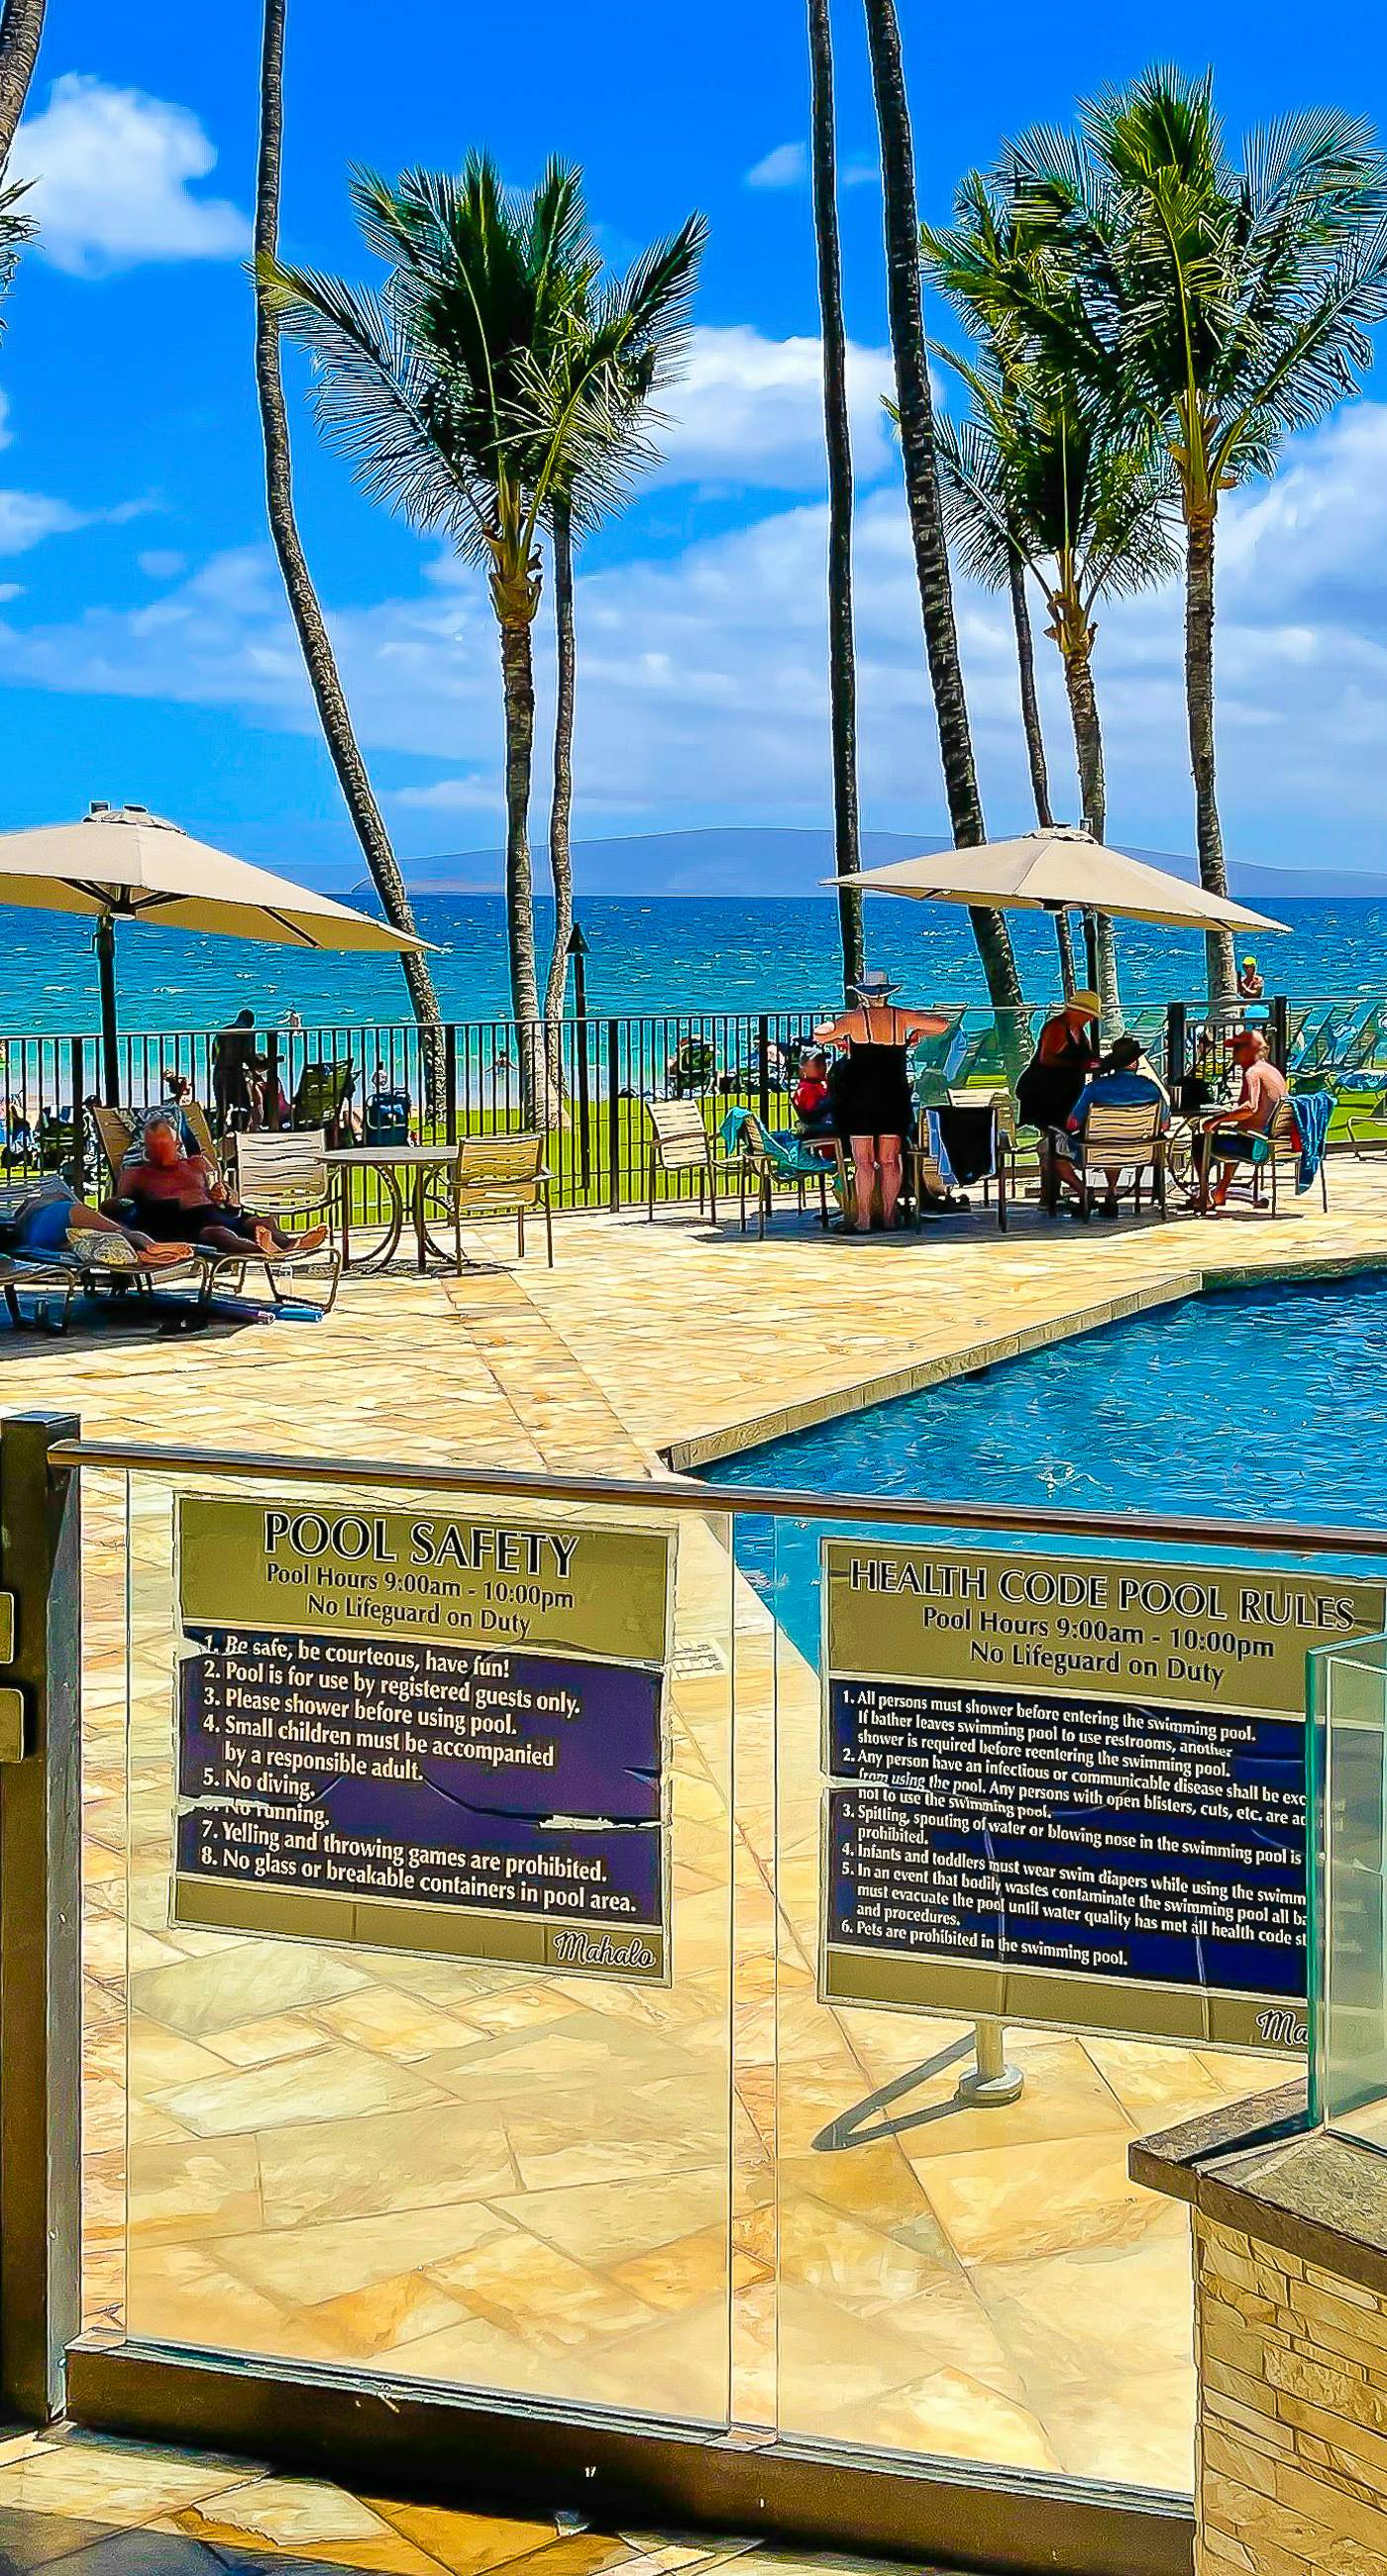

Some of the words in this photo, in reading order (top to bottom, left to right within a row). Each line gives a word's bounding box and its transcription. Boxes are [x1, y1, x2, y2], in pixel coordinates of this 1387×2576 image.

[264, 1511, 397, 1562] POOL
[410, 1521, 580, 1578] SAFETY
[267, 1562, 309, 1584] Pool
[316, 1566, 378, 1590] Hours
[384, 1571, 461, 1597] 9:00am
[483, 1581, 574, 1613] 10:00pm
[849, 1558, 988, 1600] HEALTH
[998, 1568, 1109, 1609] CODE
[1119, 1577, 1227, 1620] POOL
[1239, 1588, 1355, 1632] RULES
[308, 1594, 339, 1616] No
[346, 1596, 440, 1627] Lifeguard
[447, 1610, 473, 1628] on
[480, 1609, 530, 1640] Duty
[923, 1606, 972, 1630] Pool
[980, 1611, 1048, 1636] Hours
[1056, 1617, 1143, 1645] 9:00am
[1170, 1628, 1275, 1661] 10:00pm
[204, 1635, 219, 1655] 1.
[222, 1635, 248, 1656] Be
[253, 1637, 292, 1661] safe,
[298, 1639, 319, 1660] be
[325, 1647, 419, 1672] courteous,
[425, 1649, 468, 1673] have
[473, 1655, 508, 1677] fun!
[970, 1640, 1005, 1664] No
[1012, 1643, 1120, 1676] Lifeguard
[1128, 1659, 1158, 1677] on
[1167, 1658, 1225, 1693] Duty
[203, 1660, 220, 1677] 2.
[226, 1661, 263, 1682] Pool
[268, 1663, 282, 1684] is
[287, 1664, 313, 1685] for
[319, 1673, 348, 1689] use
[354, 1670, 374, 1698] by
[380, 1674, 470, 1701] registered
[475, 1688, 531, 1709] guests
[536, 1690, 580, 1718] only.
[203, 1686, 220, 1705] 3.
[226, 1687, 279, 1711] Please
[284, 1692, 349, 1717] shower
[354, 1698, 412, 1724] before
[417, 1706, 466, 1735] using
[470, 1713, 516, 1737] pool.
[203, 1713, 219, 1732] 4.
[225, 1715, 272, 1737] Small
[277, 1719, 351, 1745] children
[356, 1733, 399, 1751] must
[401, 1731, 427, 1753] be
[432, 1740, 553, 1767] accompanied
[843, 1689, 854, 1703] 1.
[857, 1689, 875, 1704] All
[878, 1695, 926, 1710] persons
[930, 1699, 962, 1712] must
[965, 1698, 1014, 1716] shower
[1016, 1702, 1059, 1721] before
[1063, 1710, 1119, 1730] entering
[1122, 1712, 1143, 1729] the
[1147, 1716, 1217, 1741] swimming
[1220, 1725, 1255, 1742] pool.
[858, 1708, 868, 1724] If
[871, 1709, 911, 1727] bather
[915, 1714, 954, 1731] leaves
[957, 1718, 1024, 1741] swimming
[1027, 1725, 1057, 1743] pool
[1061, 1728, 1075, 1741] to
[1078, 1732, 1102, 1744] use
[1105, 1734, 1176, 1753] restrooms,
[1179, 1742, 1232, 1757] another
[224, 1740, 247, 1768] by
[251, 1749, 261, 1764] a
[267, 1751, 367, 1774] responsible
[371, 1757, 423, 1780] adult.
[842, 1747, 855, 1762] 2.
[857, 1749, 882, 1768] Any
[886, 1754, 928, 1769] person
[932, 1754, 962, 1771] have
[965, 1761, 981, 1772] an
[985, 1759, 1049, 1778] infectious
[1052, 1770, 1067, 1780] or
[1071, 1771, 1170, 1791] communicable
[1173, 1776, 1223, 1796] disease
[1226, 1782, 1258, 1799] shall
[1262, 1785, 1279, 1802] be
[857, 1728, 904, 1746] shower
[907, 1732, 917, 1747] is
[921, 1736, 975, 1754] required
[979, 1739, 1021, 1757] before
[1024, 1747, 1094, 1768] reentering
[1098, 1749, 1119, 1766] the
[1121, 1754, 1191, 1776] swimming
[1195, 1762, 1229, 1777] pool.
[202, 1767, 219, 1786] 5.
[225, 1769, 251, 1789] No
[257, 1771, 315, 1801] diving.
[257, 1803, 330, 1831] running.
[842, 1802, 854, 1817] 3.
[857, 1804, 909, 1826] Spitting,
[912, 1812, 969, 1833] spouting
[972, 1816, 986, 1830] of
[987, 1820, 1025, 1834] water
[1028, 1825, 1043, 1836] or
[1047, 1823, 1102, 1848] blowing
[1105, 1834, 1135, 1847] nose
[1139, 1833, 1152, 1849] in
[1157, 1835, 1179, 1852] the
[1181, 1840, 1252, 1864] swimming
[1255, 1848, 1286, 1865] pool
[1290, 1849, 1301, 1864] is
[858, 1825, 928, 1845] prohibited.
[201, 1819, 218, 1838] 7.
[221, 1821, 279, 1852] Yelling
[283, 1831, 317, 1850] and
[323, 1833, 404, 1866] throwing
[408, 1848, 466, 1868] games
[470, 1854, 500, 1871] are
[505, 1854, 606, 1881] prohibited.
[841, 1842, 854, 1856] 4.
[857, 1843, 901, 1861] Infants
[904, 1849, 928, 1864] and
[932, 1852, 985, 1870] toddlers
[988, 1860, 1019, 1875] must
[1022, 1864, 1055, 1878] wear
[1058, 1866, 1094, 1882] swim
[1098, 1869, 1147, 1890] diapers
[1150, 1876, 1188, 1892] while
[1192, 1880, 1228, 1901] using
[1231, 1883, 1253, 1900] the
[201, 1845, 217, 1865] 8.
[223, 1848, 250, 1869] No
[254, 1852, 296, 1877] glass
[301, 1863, 321, 1878] or
[326, 1859, 414, 1888] breakable
[419, 1876, 515, 1899] containers
[520, 1880, 537, 1902] in
[543, 1886, 584, 1909] pool
[589, 1893, 636, 1911] area.
[553, 1931, 656, 1969] Mahalo
[841, 1919, 853, 1933] 6.
[856, 1920, 882, 1936] Pets
[885, 1926, 907, 1939] are
[909, 1927, 977, 1947] prohibited
[981, 1933, 994, 1949] in
[998, 1936, 1017, 1951] the
[1020, 1940, 1089, 1965] swimming
[1093, 1950, 1127, 1966] pool.
